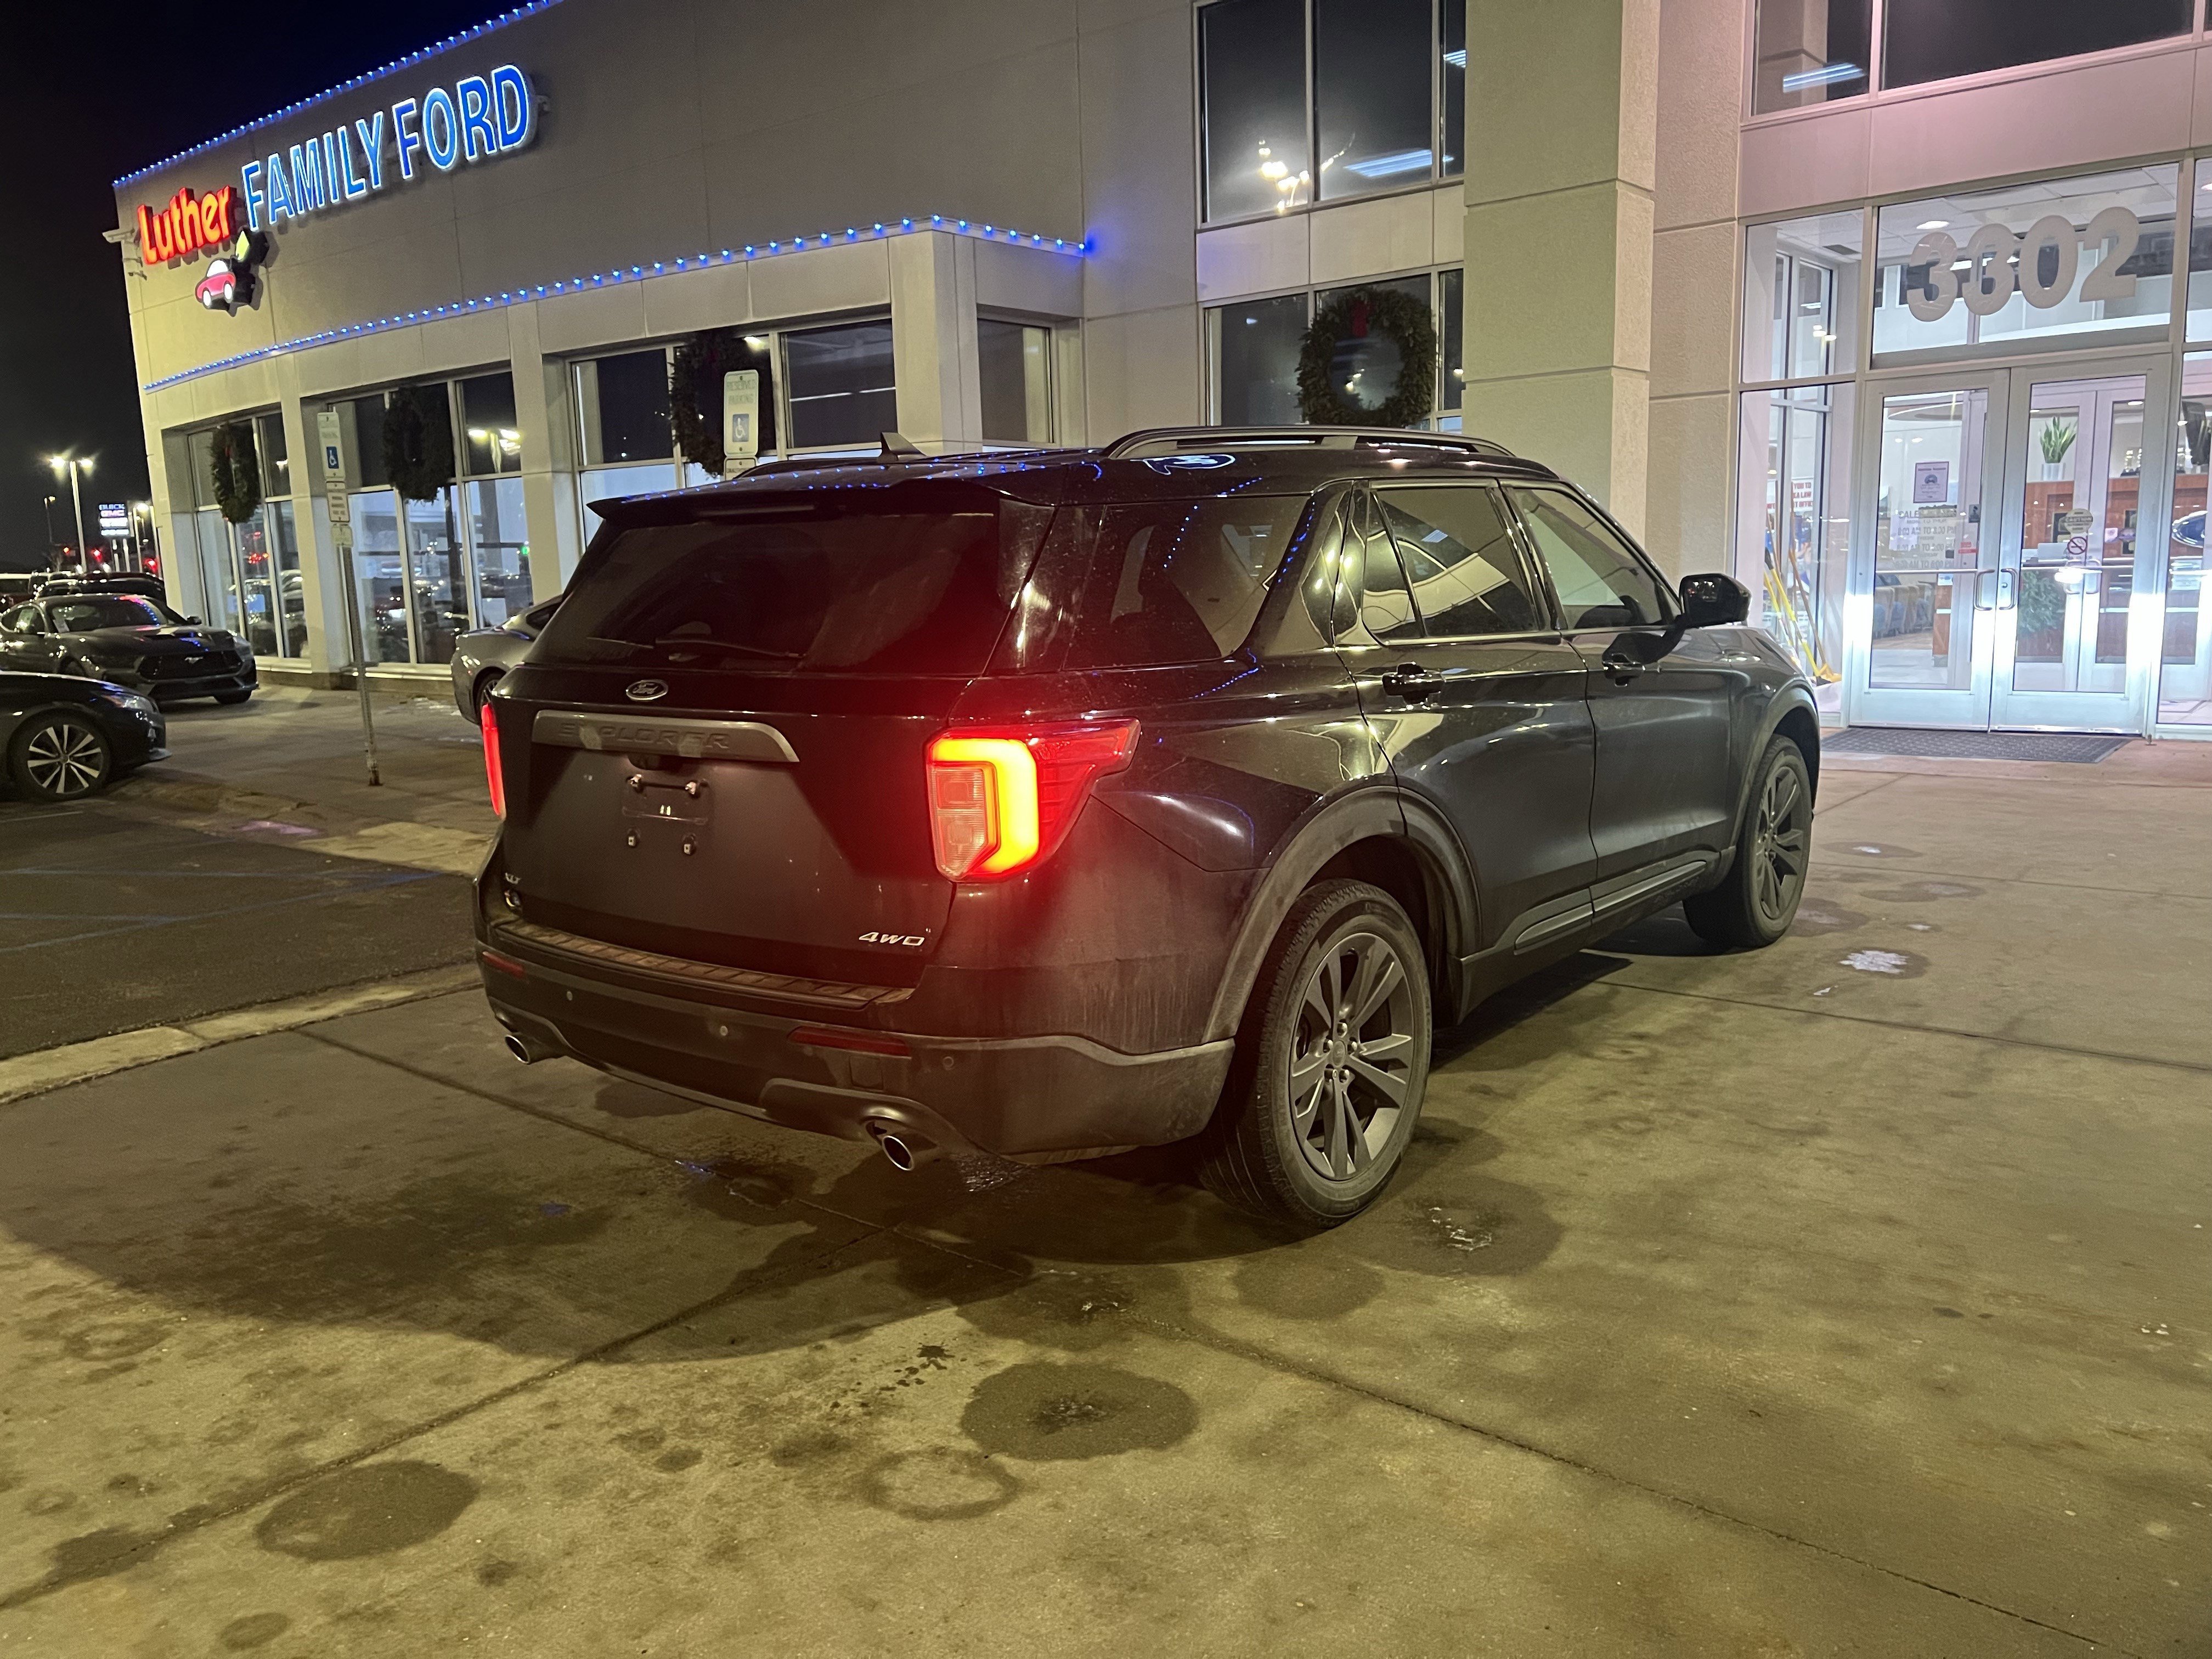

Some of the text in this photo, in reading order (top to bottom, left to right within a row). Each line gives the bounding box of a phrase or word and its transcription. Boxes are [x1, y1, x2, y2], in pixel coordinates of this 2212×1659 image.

[137, 64, 531, 265] Luther FAMILY FORD
[1906, 206, 2141, 322] 3302
[557, 721, 730, 749] EPLORER
[859, 932, 925, 946] 4WD
